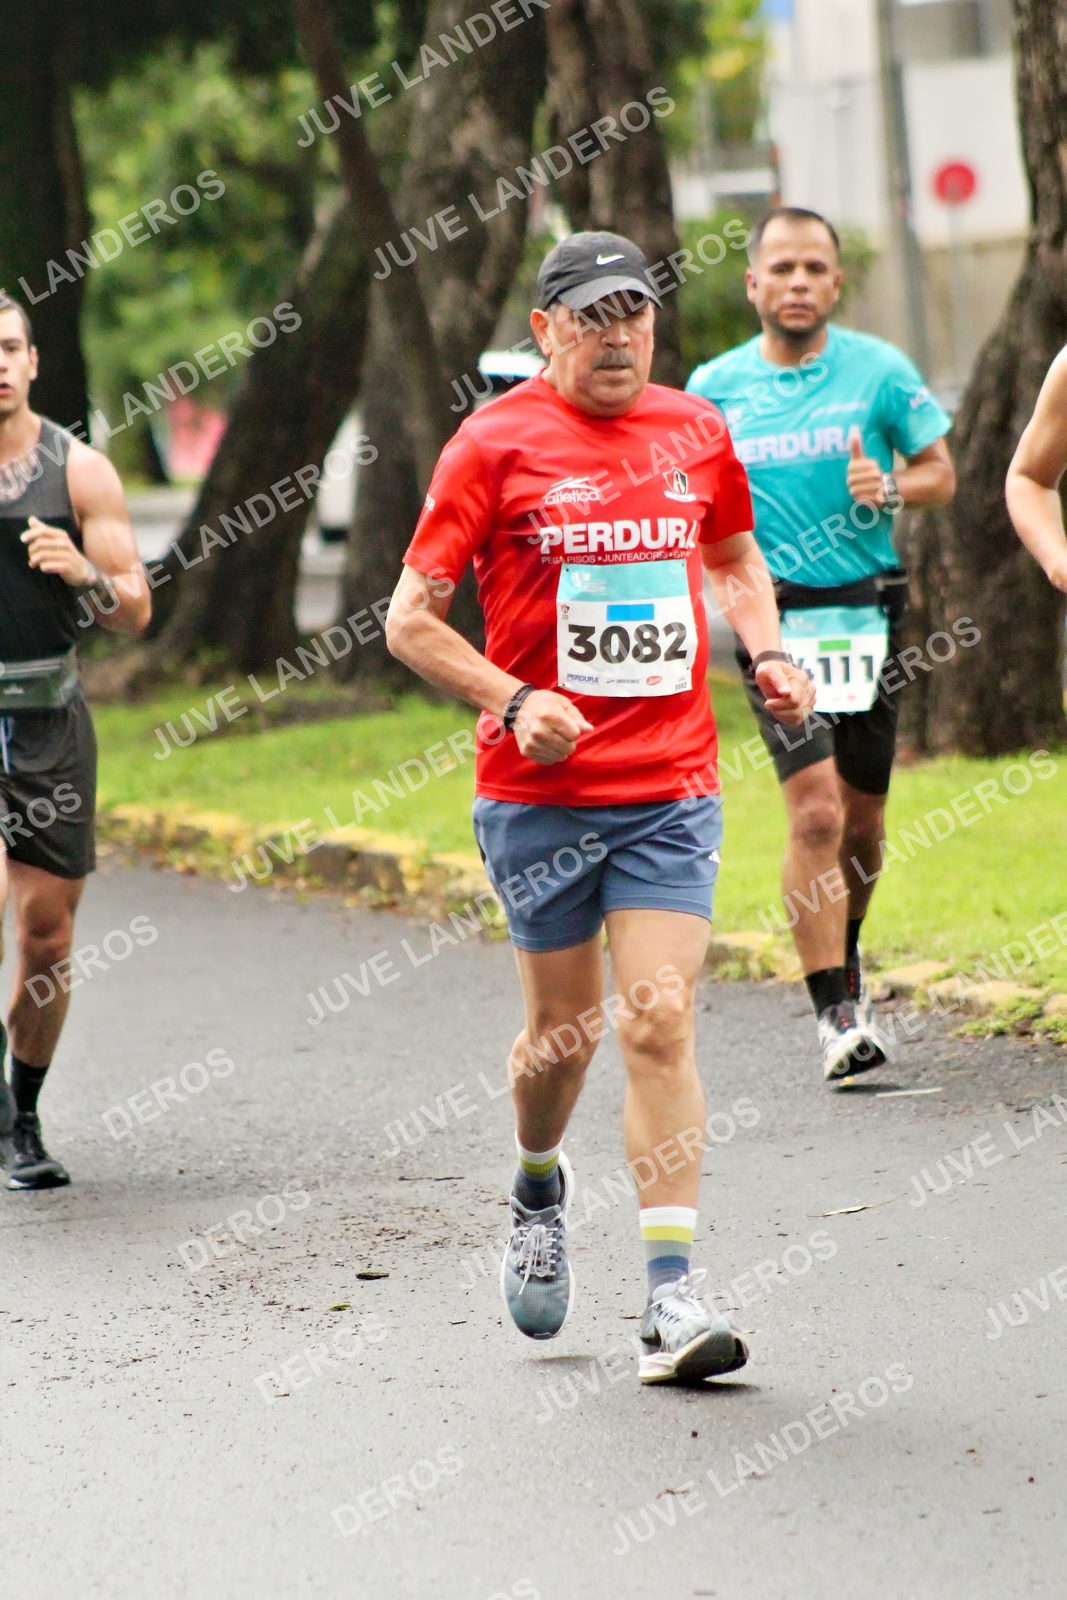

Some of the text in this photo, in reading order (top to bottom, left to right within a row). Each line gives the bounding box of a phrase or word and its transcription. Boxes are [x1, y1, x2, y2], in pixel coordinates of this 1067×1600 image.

[545, 488, 599, 505] atletica
[567, 555, 596, 563] PISOS
[567, 622, 688, 664] 3082
